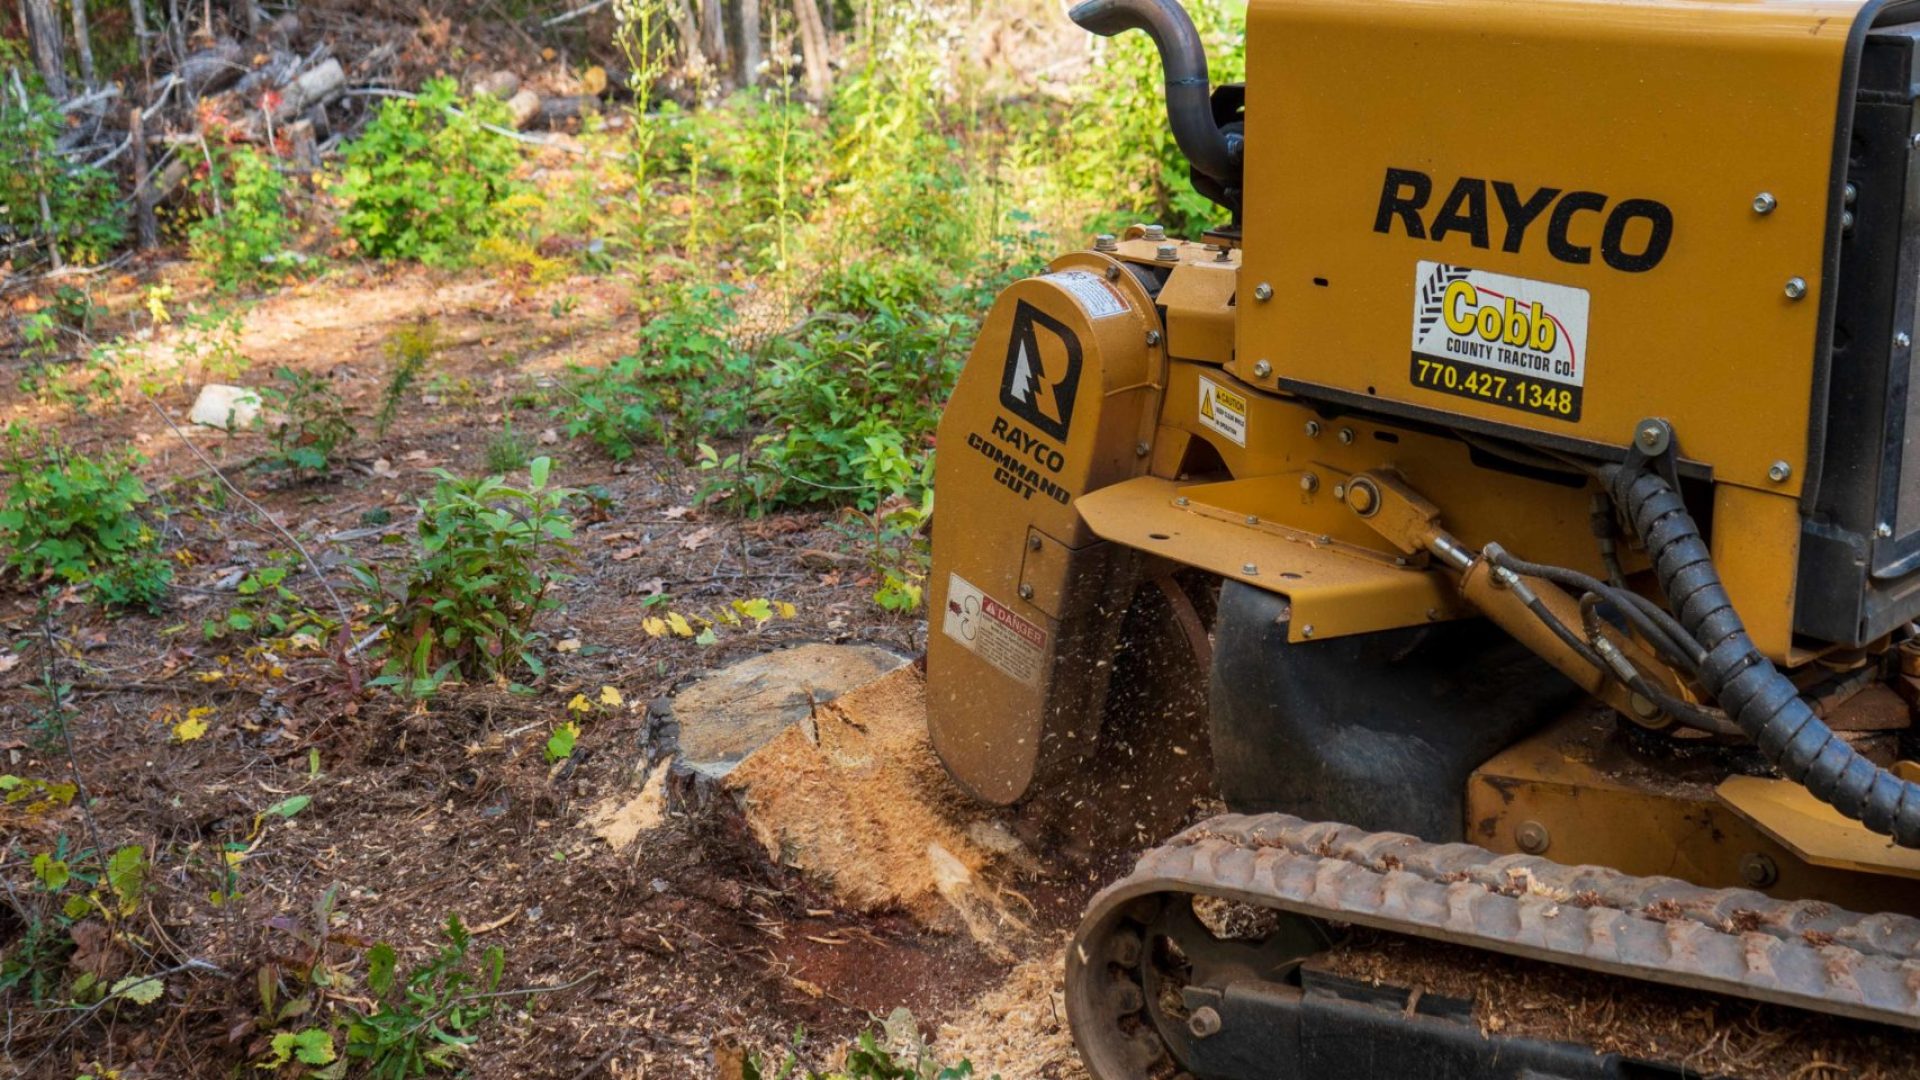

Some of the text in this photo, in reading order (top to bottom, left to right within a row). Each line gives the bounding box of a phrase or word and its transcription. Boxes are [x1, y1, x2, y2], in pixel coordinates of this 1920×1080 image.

[1373, 167, 1674, 273] RAYCO
[1442, 279, 1557, 354] Cobb
[1446, 337, 1493, 360] COUNTY
[1497, 348, 1549, 372] TRACTOR
[1221, 392, 1245, 412] CAUTION
[1417, 359, 1573, 414] 770.427.1348
[967, 432, 1071, 506] COMMAND
[991, 415, 1065, 473] RAYCO
[993, 467, 1037, 501] CUT
[997, 609, 1042, 642] DANGER
